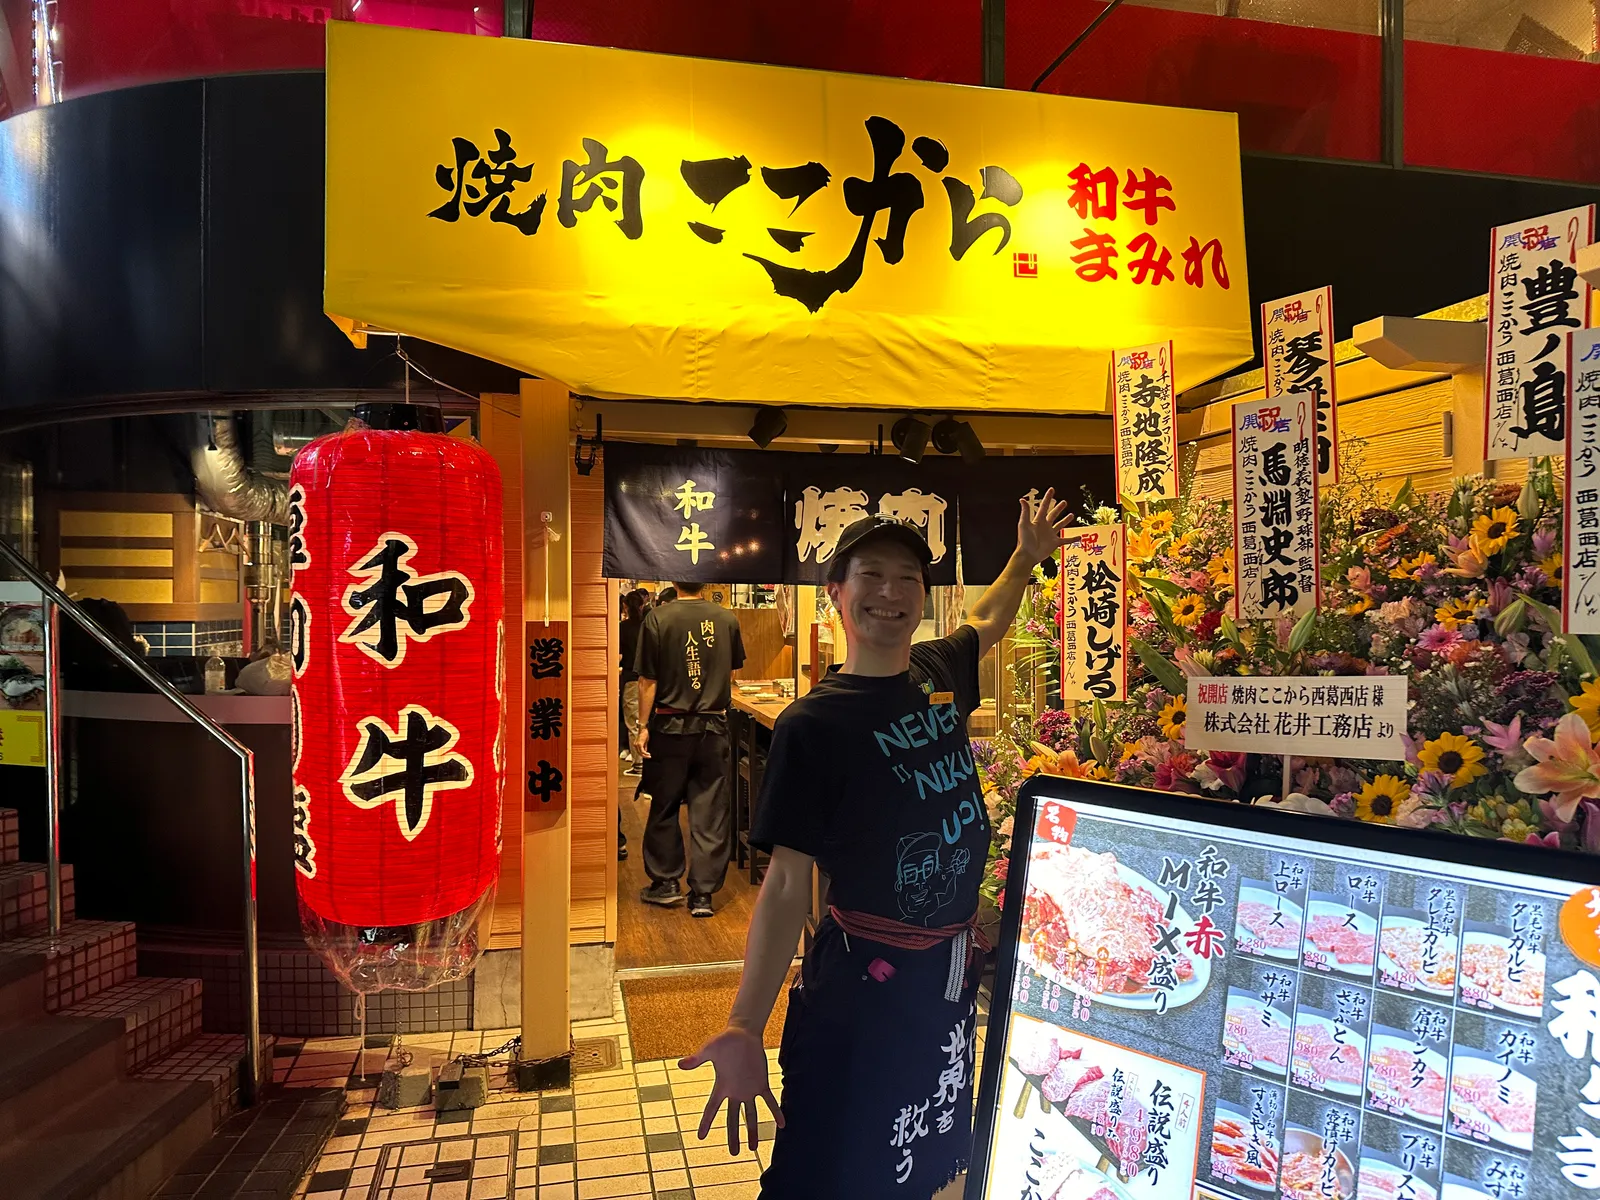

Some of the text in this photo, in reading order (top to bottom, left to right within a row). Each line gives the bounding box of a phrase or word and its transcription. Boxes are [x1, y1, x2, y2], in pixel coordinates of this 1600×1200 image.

[1066, 162, 1177, 225] 和牛
[1069, 228, 1231, 290] まみれ
[1131, 374, 1168, 496] 寺地隆成
[1156, 370, 1174, 473] 千葉ロッテマリーンズ
[673, 479, 716, 566] 和牛
[1258, 442, 1298, 613] 馬淵史郎
[700, 619, 715, 649] 肉で
[1077, 560, 1122, 699] 松崎しげる
[338, 531, 474, 842] 和牛
[685, 630, 702, 692] 人生語る
[528, 637, 565, 803] 営業中
[1197, 683, 1228, 705] 祝開店
[1231, 684, 1369, 707] 焼肉ここから西葛西店
[1203, 711, 1395, 739] 株式会社 花井工務店 より
[873, 702, 960, 757] NEVER
[1045, 805, 1069, 842] 名物
[1269, 861, 1291, 929] 上ロース
[1290, 863, 1304, 889] 和牛
[1342, 875, 1363, 931] ロース
[1362, 875, 1377, 903] 和牛
[1422, 887, 1443, 975] タレ上カルビ
[1440, 889, 1455, 937] 黒毛和牛
[1507, 903, 1529, 983] タレカルビ
[1527, 904, 1543, 954] 黒毛和牛
[1261, 972, 1279, 1028] ササミ
[1277, 974, 1292, 1002] 和牛
[1351, 991, 1366, 1021] 和牛
[1329, 988, 1352, 1065] ざぶとん
[1410, 1008, 1432, 1089] 肩サンカク
[1430, 1011, 1446, 1041] 和牛
[1518, 1032, 1535, 1064] 和牛
[933, 1019, 967, 1134] 世界を
[1497, 1029, 1518, 1105] カイノミ
[890, 1098, 930, 1184] 救う
[1143, 1079, 1175, 1186] 伝説盛り
[1245, 1087, 1267, 1169] すきやき風
[1340, 1112, 1355, 1142] 和牛
[1419, 1137, 1436, 1169] 和牛
[1508, 1165, 1525, 1197] 和牛
